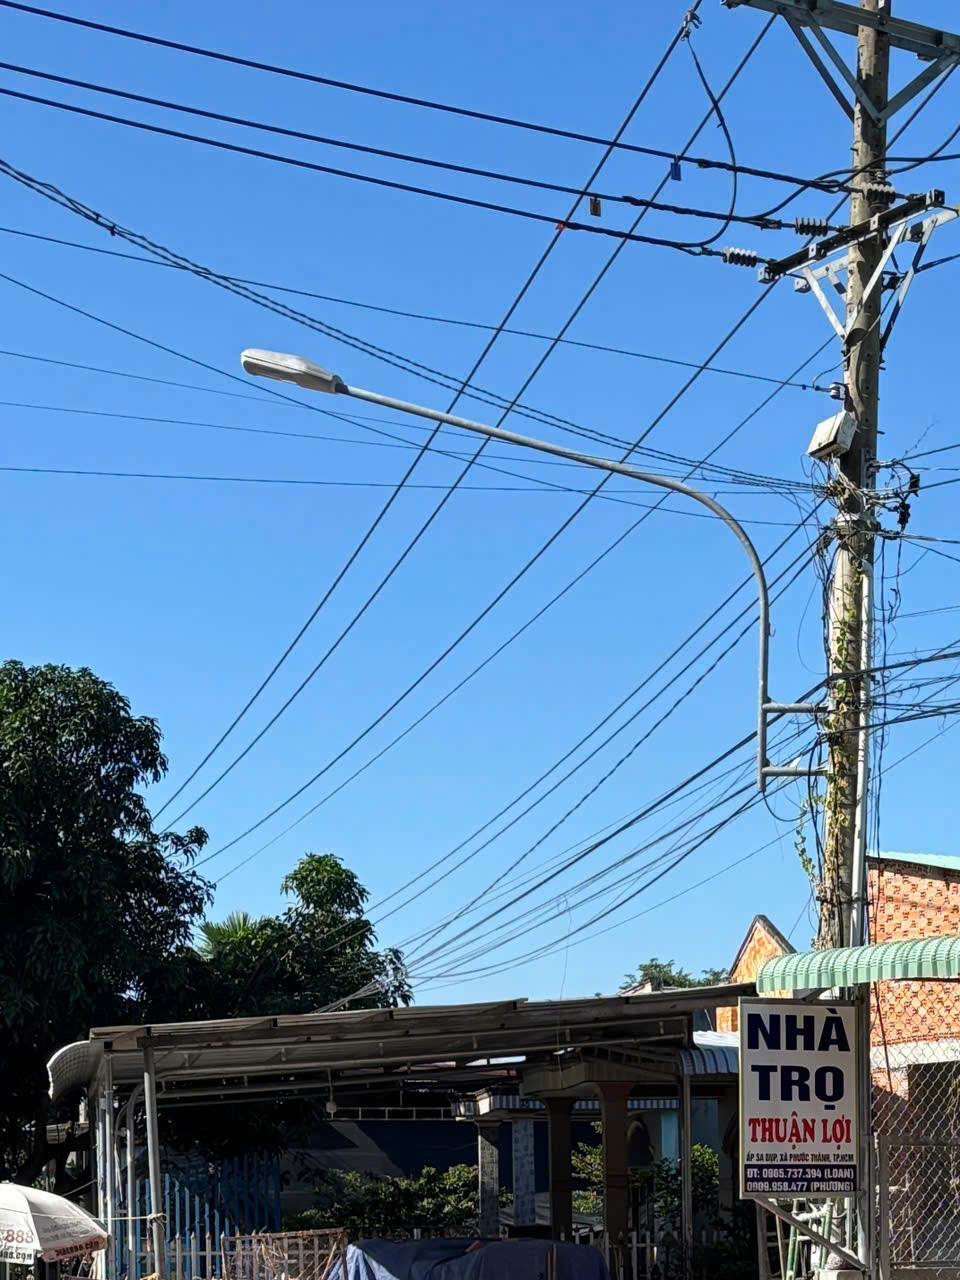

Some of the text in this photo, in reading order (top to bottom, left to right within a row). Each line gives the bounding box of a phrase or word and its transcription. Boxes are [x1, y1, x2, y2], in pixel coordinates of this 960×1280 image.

[747, 1008, 850, 1051] NHÀ
[751, 1065, 844, 1110] TRỌ
[748, 1111, 852, 1150] THUẬN LỢI
